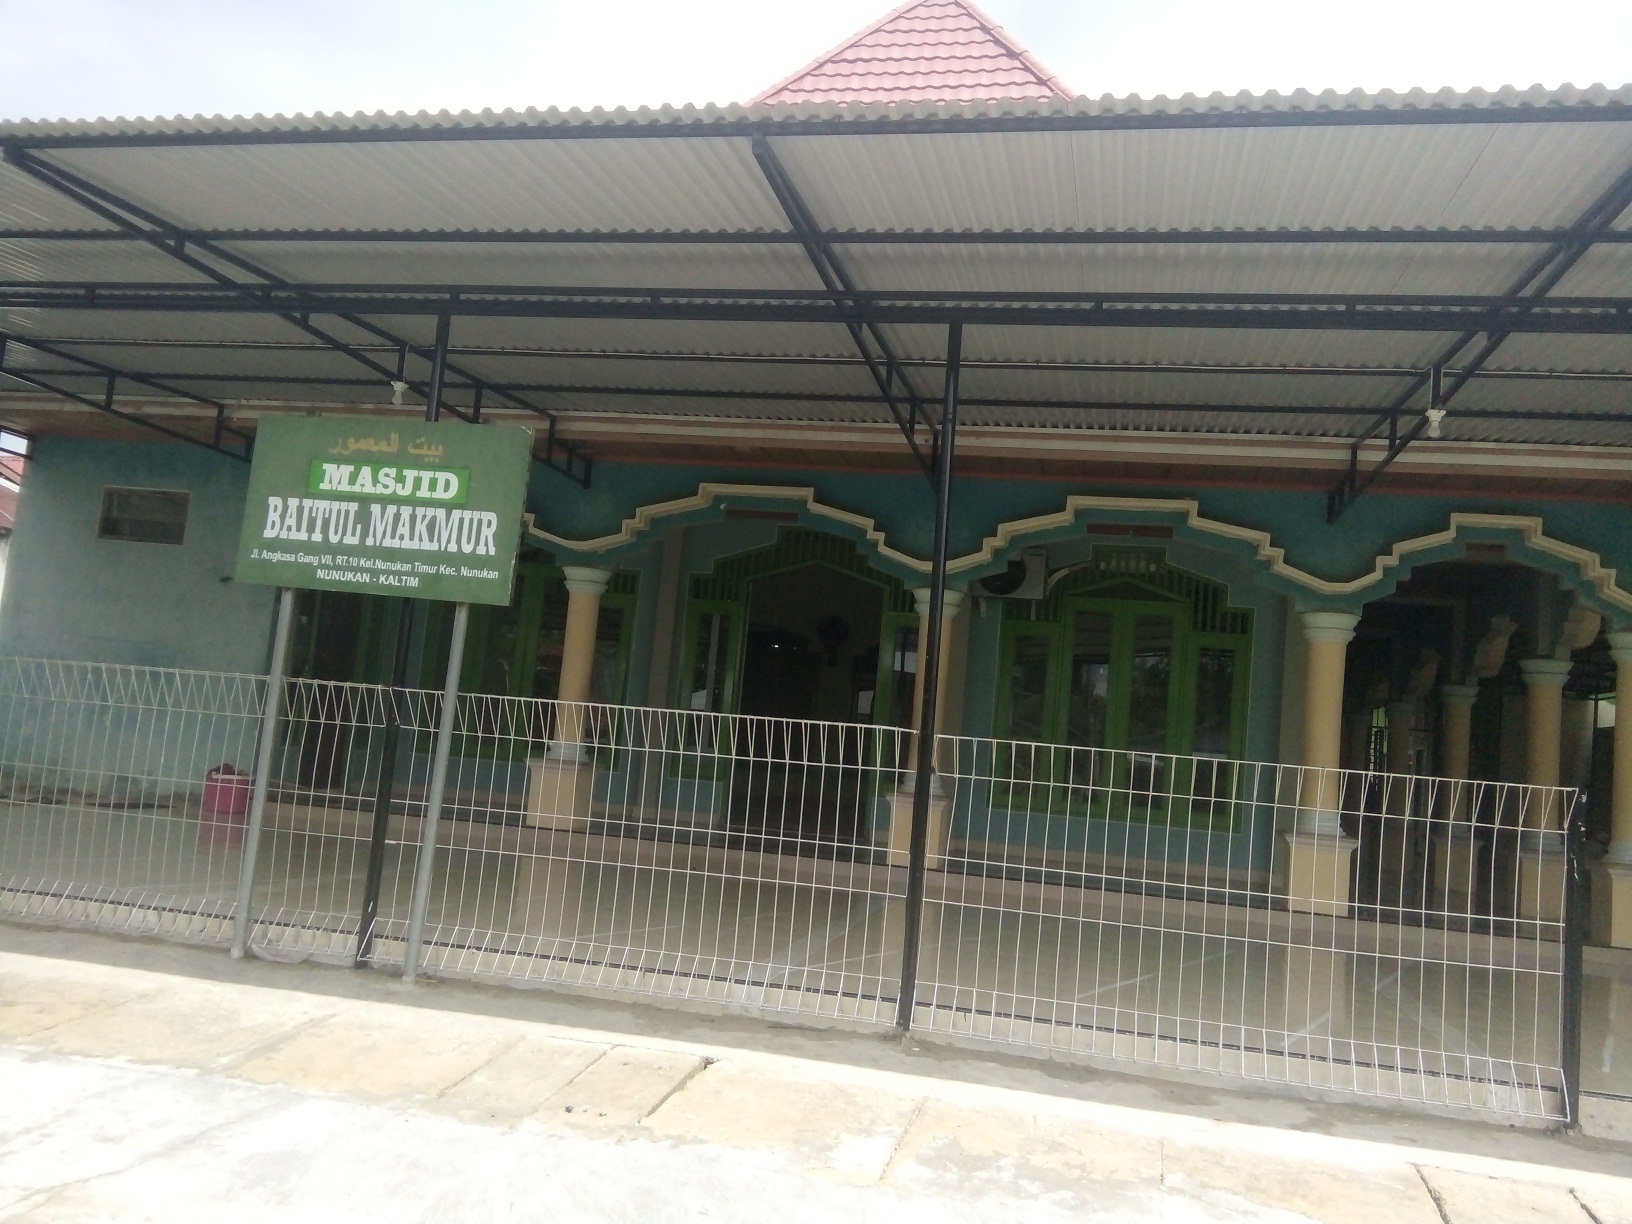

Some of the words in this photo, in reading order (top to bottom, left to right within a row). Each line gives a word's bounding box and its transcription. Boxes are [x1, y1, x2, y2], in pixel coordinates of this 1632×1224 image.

[319, 463, 459, 499] MASJID
[263, 496, 362, 545] BAITUL
[365, 503, 498, 556] MAKMUR
[261, 549, 296, 563] Angkasa
[297, 552, 319, 566] Gang
[321, 554, 334, 567] VII,
[335, 555, 358, 567] RT.10
[414, 562, 438, 574] Timur
[439, 564, 458, 575] Kec.
[460, 566, 499, 579] Nunukan
[316, 568, 370, 583] NUNUKAN
[379, 574, 419, 587] KALTIM
